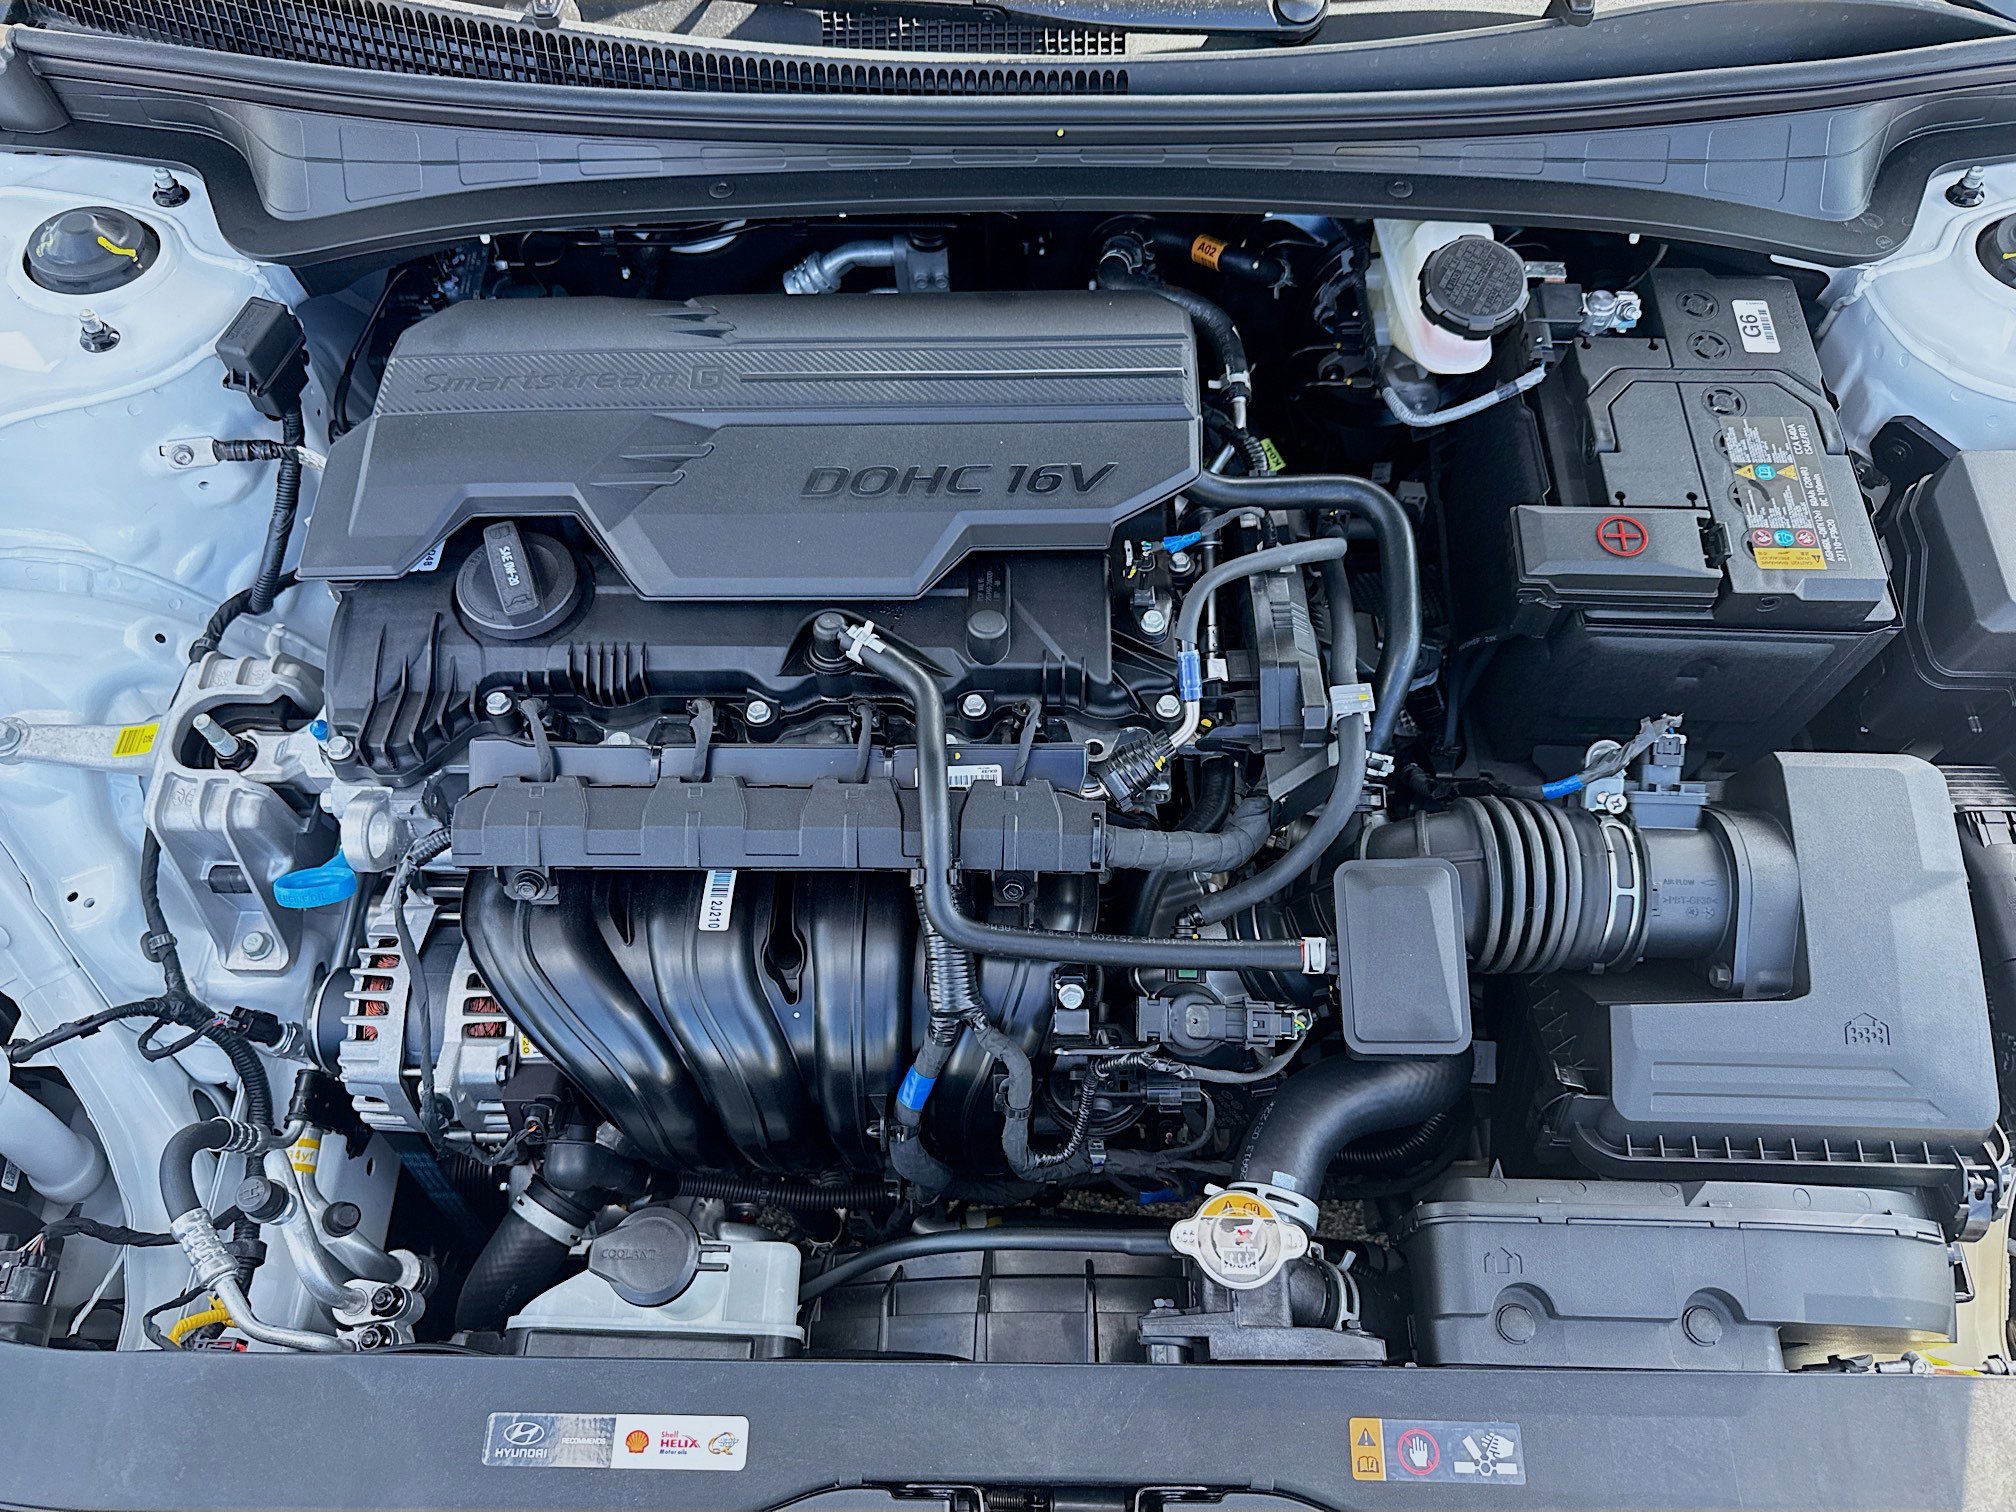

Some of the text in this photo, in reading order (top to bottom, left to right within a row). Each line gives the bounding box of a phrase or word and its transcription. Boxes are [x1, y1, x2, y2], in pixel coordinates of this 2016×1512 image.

[1197, 242, 1217, 258] A02
[1740, 314, 1762, 337] G6
[414, 370, 678, 393] Smartstream
[1787, 424, 1804, 455] CCA 640A
[800, 462, 1120, 497] DOHC 16V
[1800, 466, 1819, 507] 60Ah (20HR)
[1813, 473, 1829, 507] RC 100min
[1826, 519, 1846, 562] 37110-F9620
[499, 546, 520, 586] SAE 0W-20
[708, 900, 723, 928] 2J210
[1091, 934, 1134, 943] 251209
[601, 1248, 656, 1260] COOLANT
[561, 1437, 607, 1445] RECOMMENDS
[660, 1438, 700, 1448] HELIX
[661, 1430, 679, 1439] Shell
[495, 1447, 548, 1459] HYUNDAI
